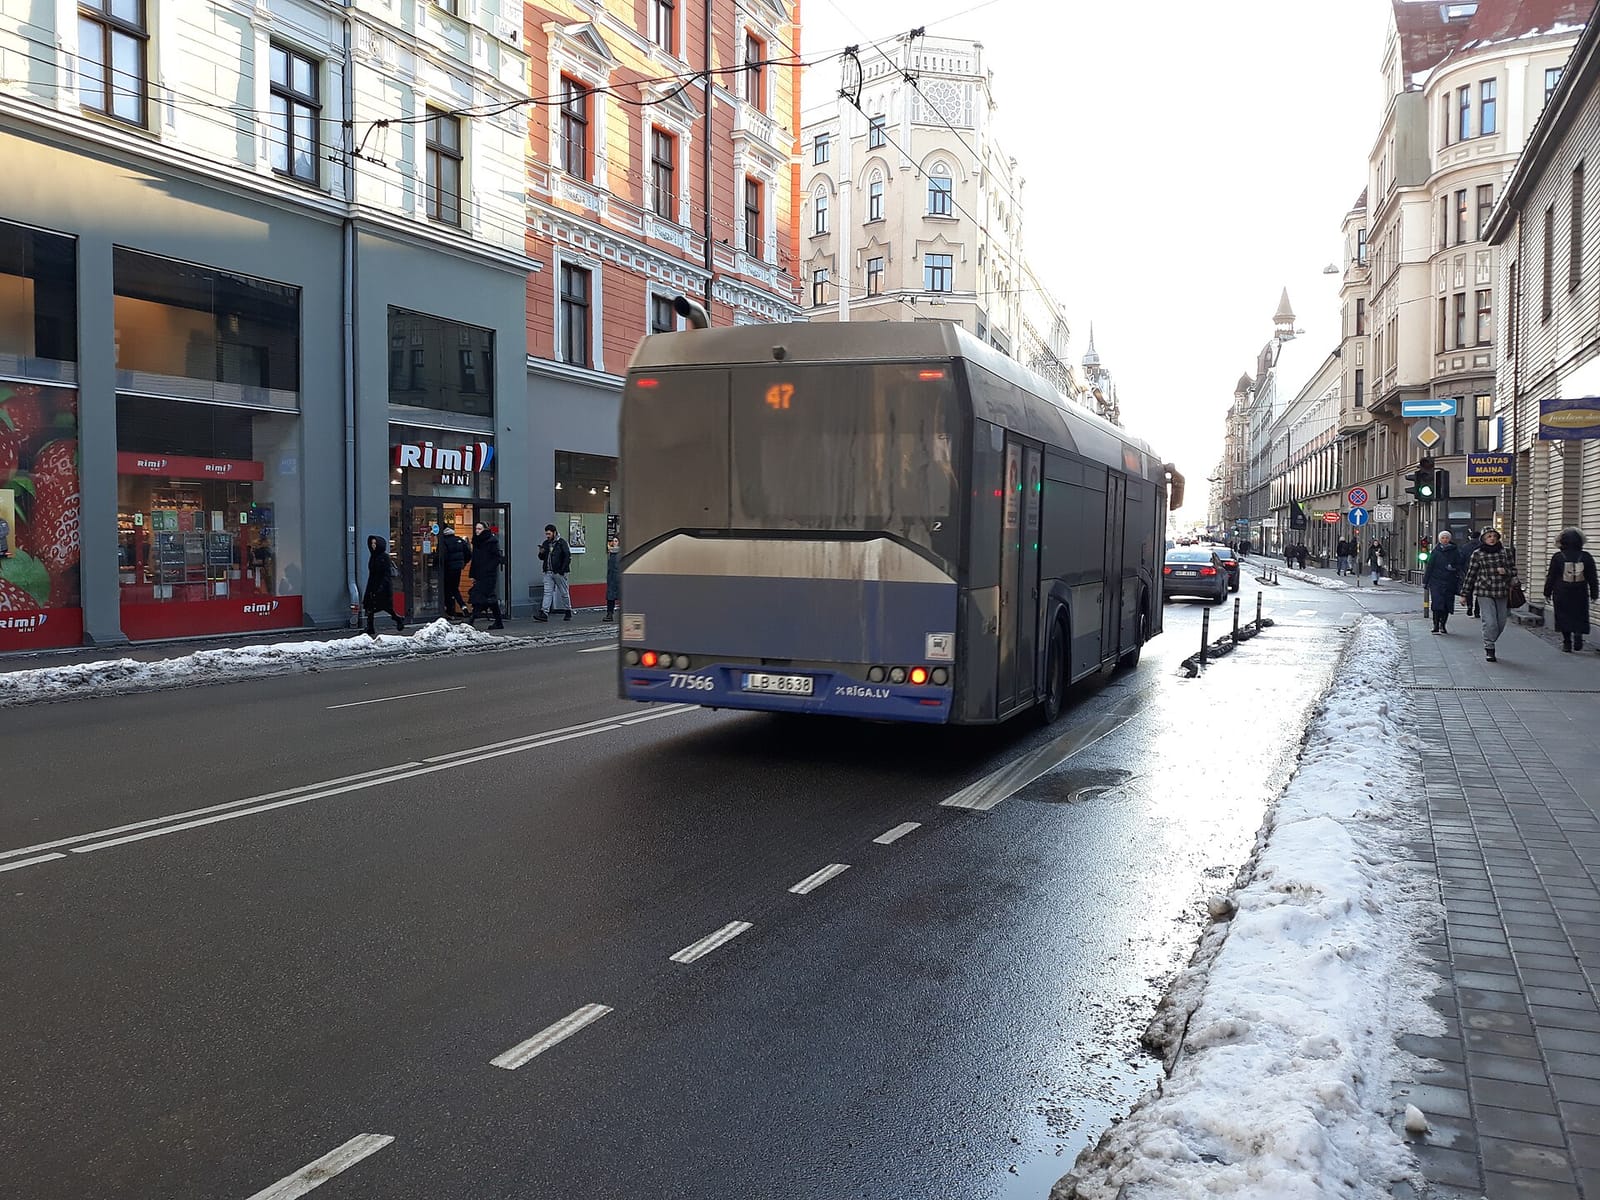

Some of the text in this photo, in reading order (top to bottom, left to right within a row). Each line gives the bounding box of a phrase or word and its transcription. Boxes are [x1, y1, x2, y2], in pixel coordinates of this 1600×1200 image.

[766, 383, 795, 408] 47
[400, 441, 473, 472] Rimi
[1470, 456, 1509, 464] VALŪTAS
[137, 459, 161, 468] Rimi
[205, 463, 226, 472] Rimi
[1475, 466, 1504, 475] MAIŅA
[933, 521, 942, 531] 2
[243, 602, 271, 613] Rimi
[669, 673, 715, 691] 77566
[750, 674, 811, 692] LB-8638
